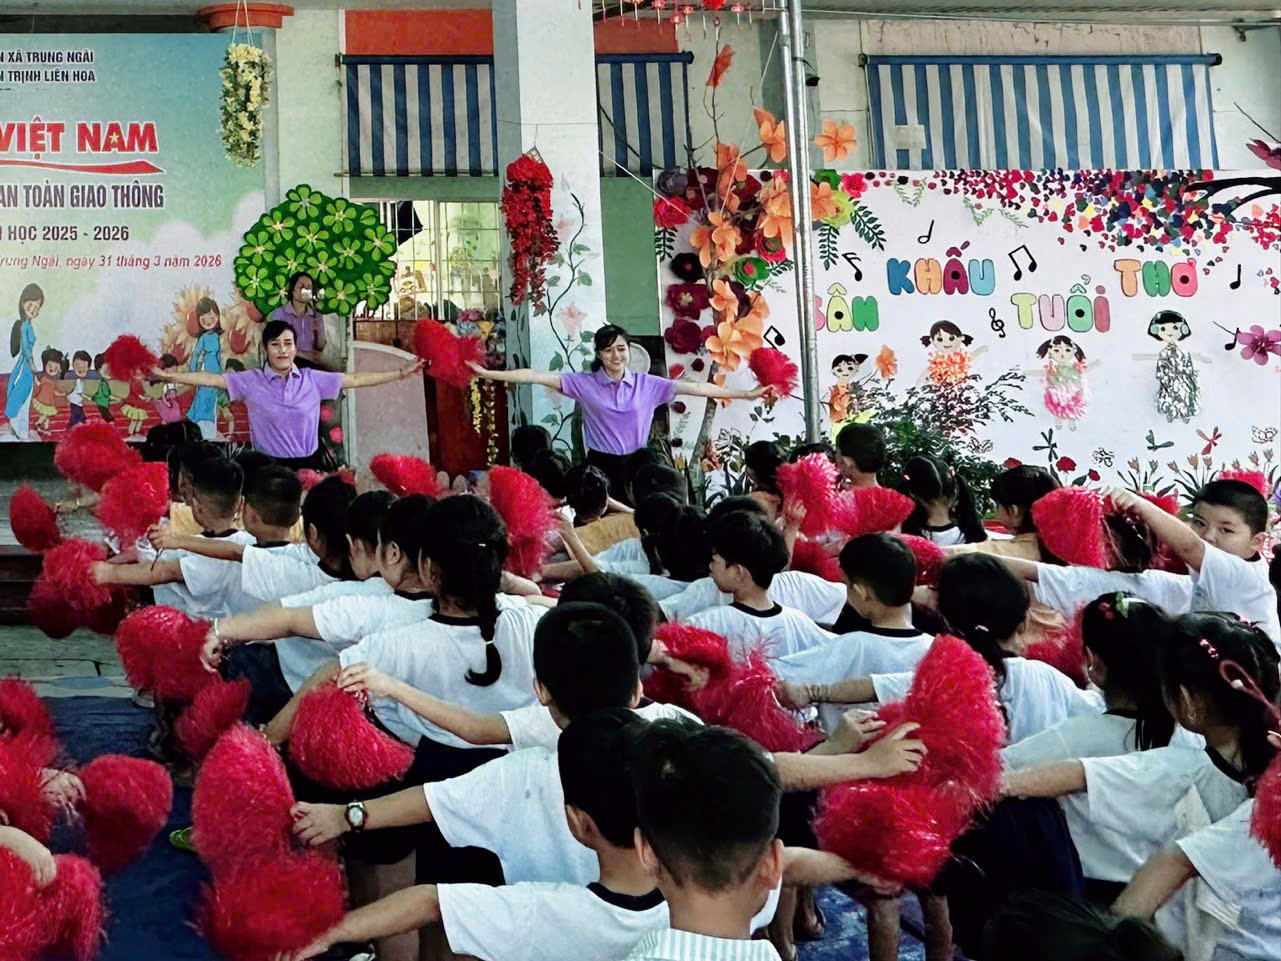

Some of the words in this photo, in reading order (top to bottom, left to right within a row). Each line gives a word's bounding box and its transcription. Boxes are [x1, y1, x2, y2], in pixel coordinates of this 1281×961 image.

[26, 51, 63, 62] TRUNG
[8, 71, 41, 84] TRỊNH
[45, 68, 69, 82] LIÊN
[73, 71, 95, 82] HOA
[77, 123, 158, 152] NAM
[23, 179, 65, 208] TOÀN
[70, 184, 107, 208] GIAO
[111, 179, 164, 208] THÔNG
[8, 225, 38, 245] HỌC
[42, 226, 78, 241] 2025
[93, 226, 129, 241] 2026
[98, 255, 112, 267] 31
[153, 255, 161, 267] 3
[194, 254, 222, 267] 2026
[887, 241, 996, 296] KHẤU
[1010, 274, 1111, 333] TUỔI
[1114, 257, 1199, 298] THƠ
